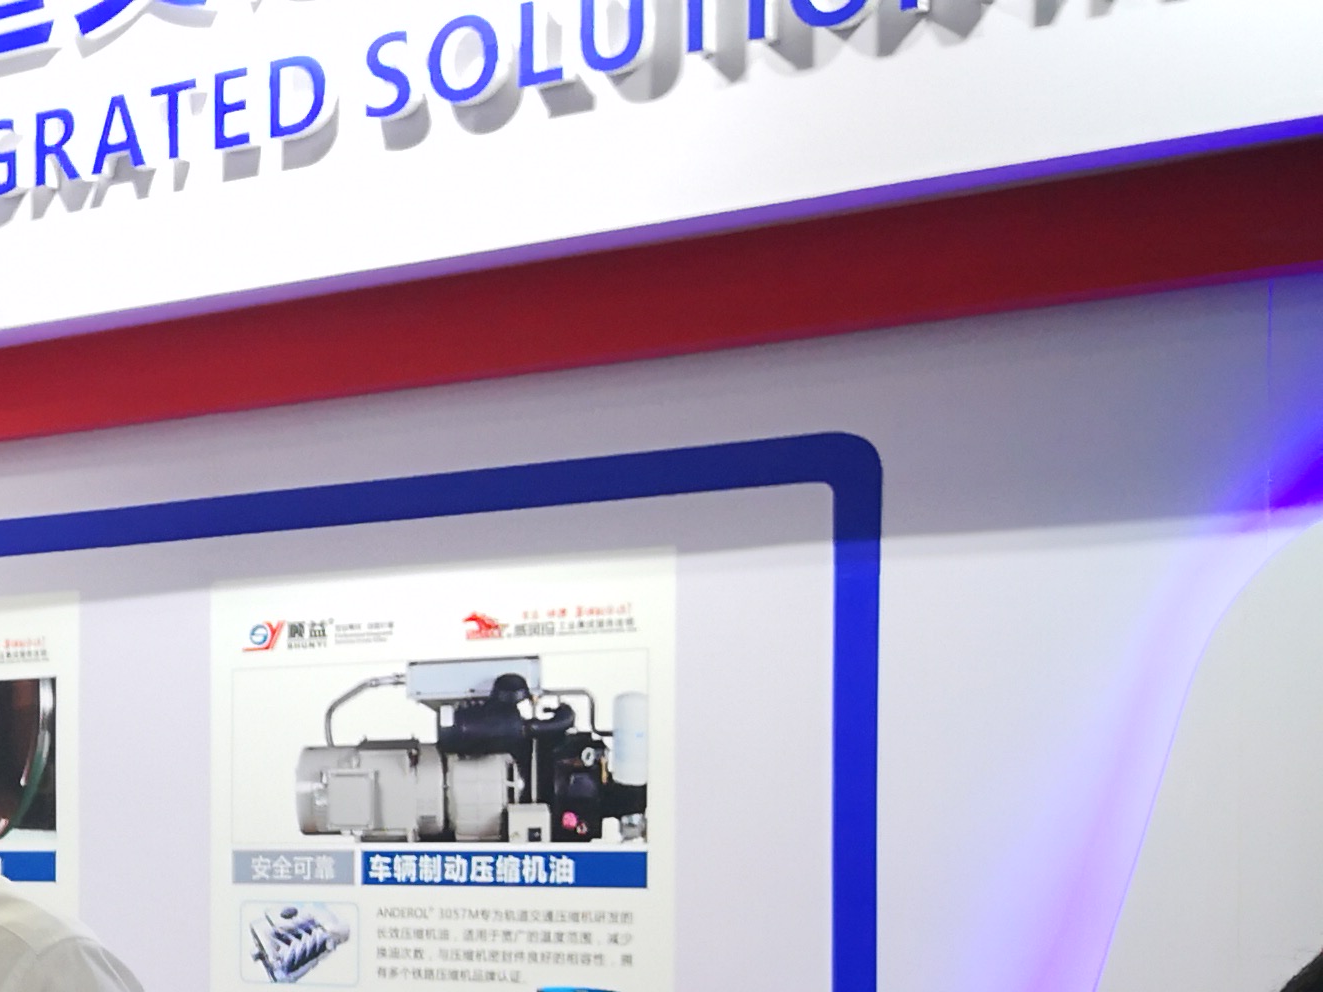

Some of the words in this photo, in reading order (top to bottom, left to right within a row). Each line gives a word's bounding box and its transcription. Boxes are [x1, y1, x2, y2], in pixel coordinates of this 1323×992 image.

[250, 854, 335, 880] 安全可靠
[367, 853, 576, 885] 车辆制动压缩机油
